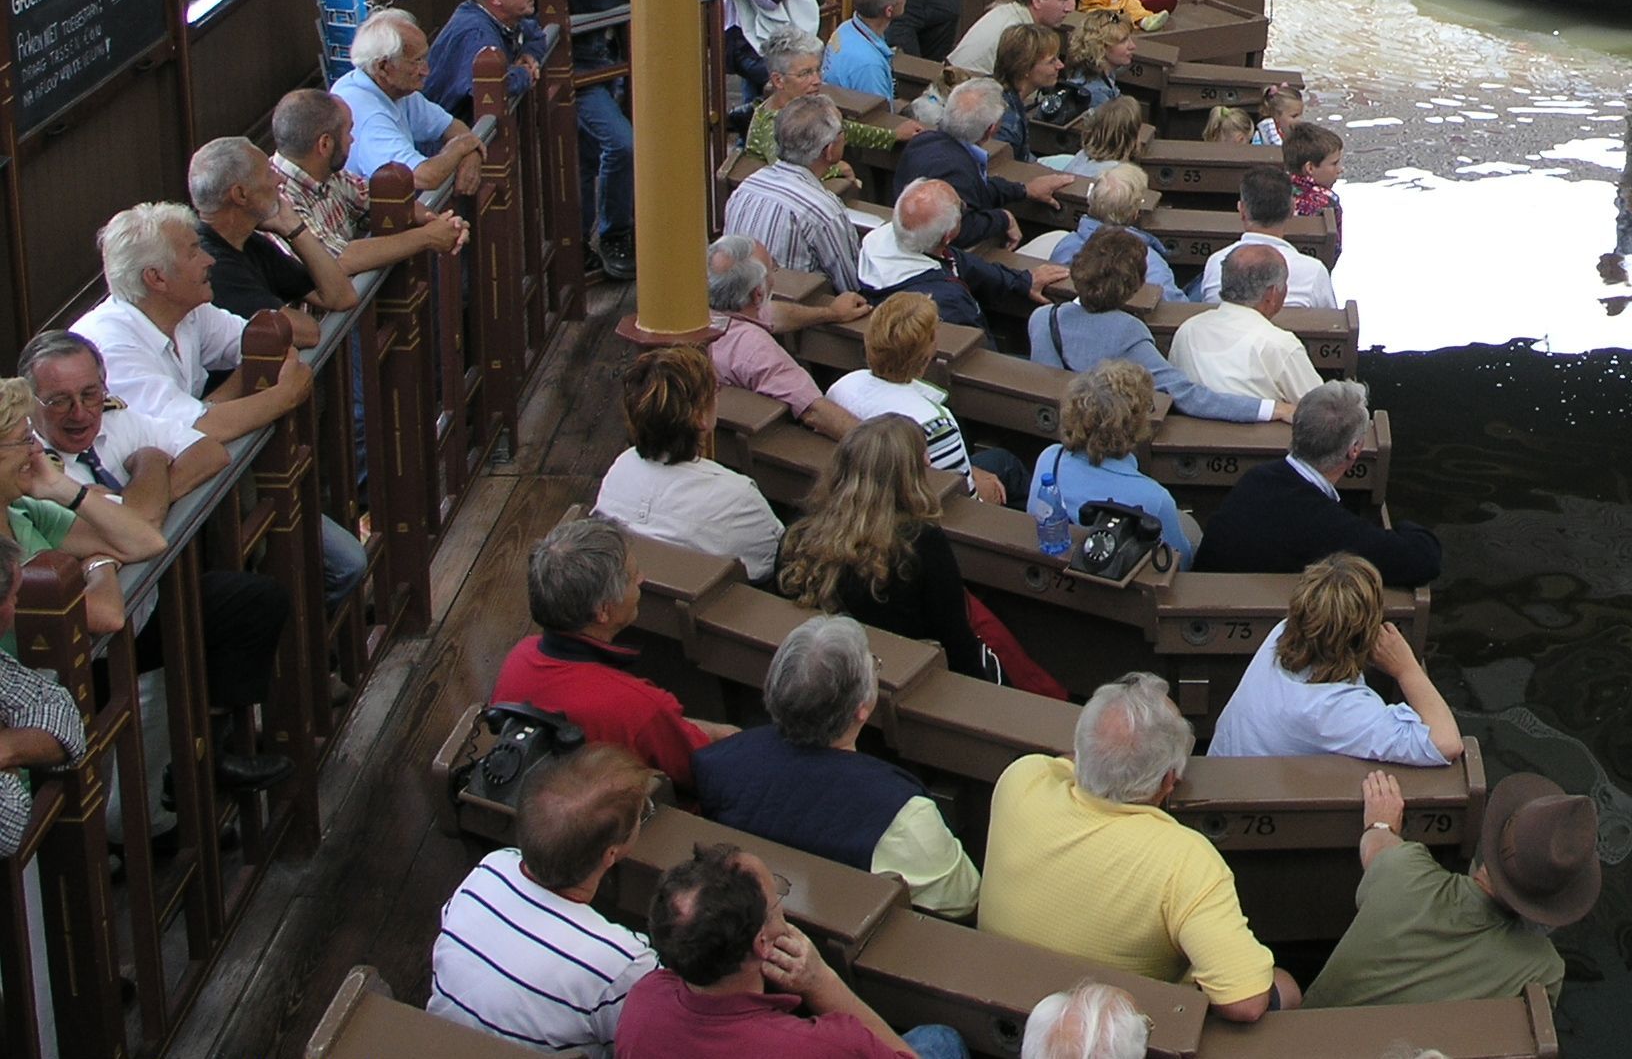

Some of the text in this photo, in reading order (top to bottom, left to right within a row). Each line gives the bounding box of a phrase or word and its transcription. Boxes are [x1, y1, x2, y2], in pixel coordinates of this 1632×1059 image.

[1184, 170, 1200, 183] 53
[1191, 243, 1211, 256] 58
[1320, 344, 1341, 359] 64
[1210, 457, 1239, 473] 68
[1225, 621, 1252, 638] 73
[1240, 815, 1275, 834] 78
[1422, 814, 1452, 833] 79
